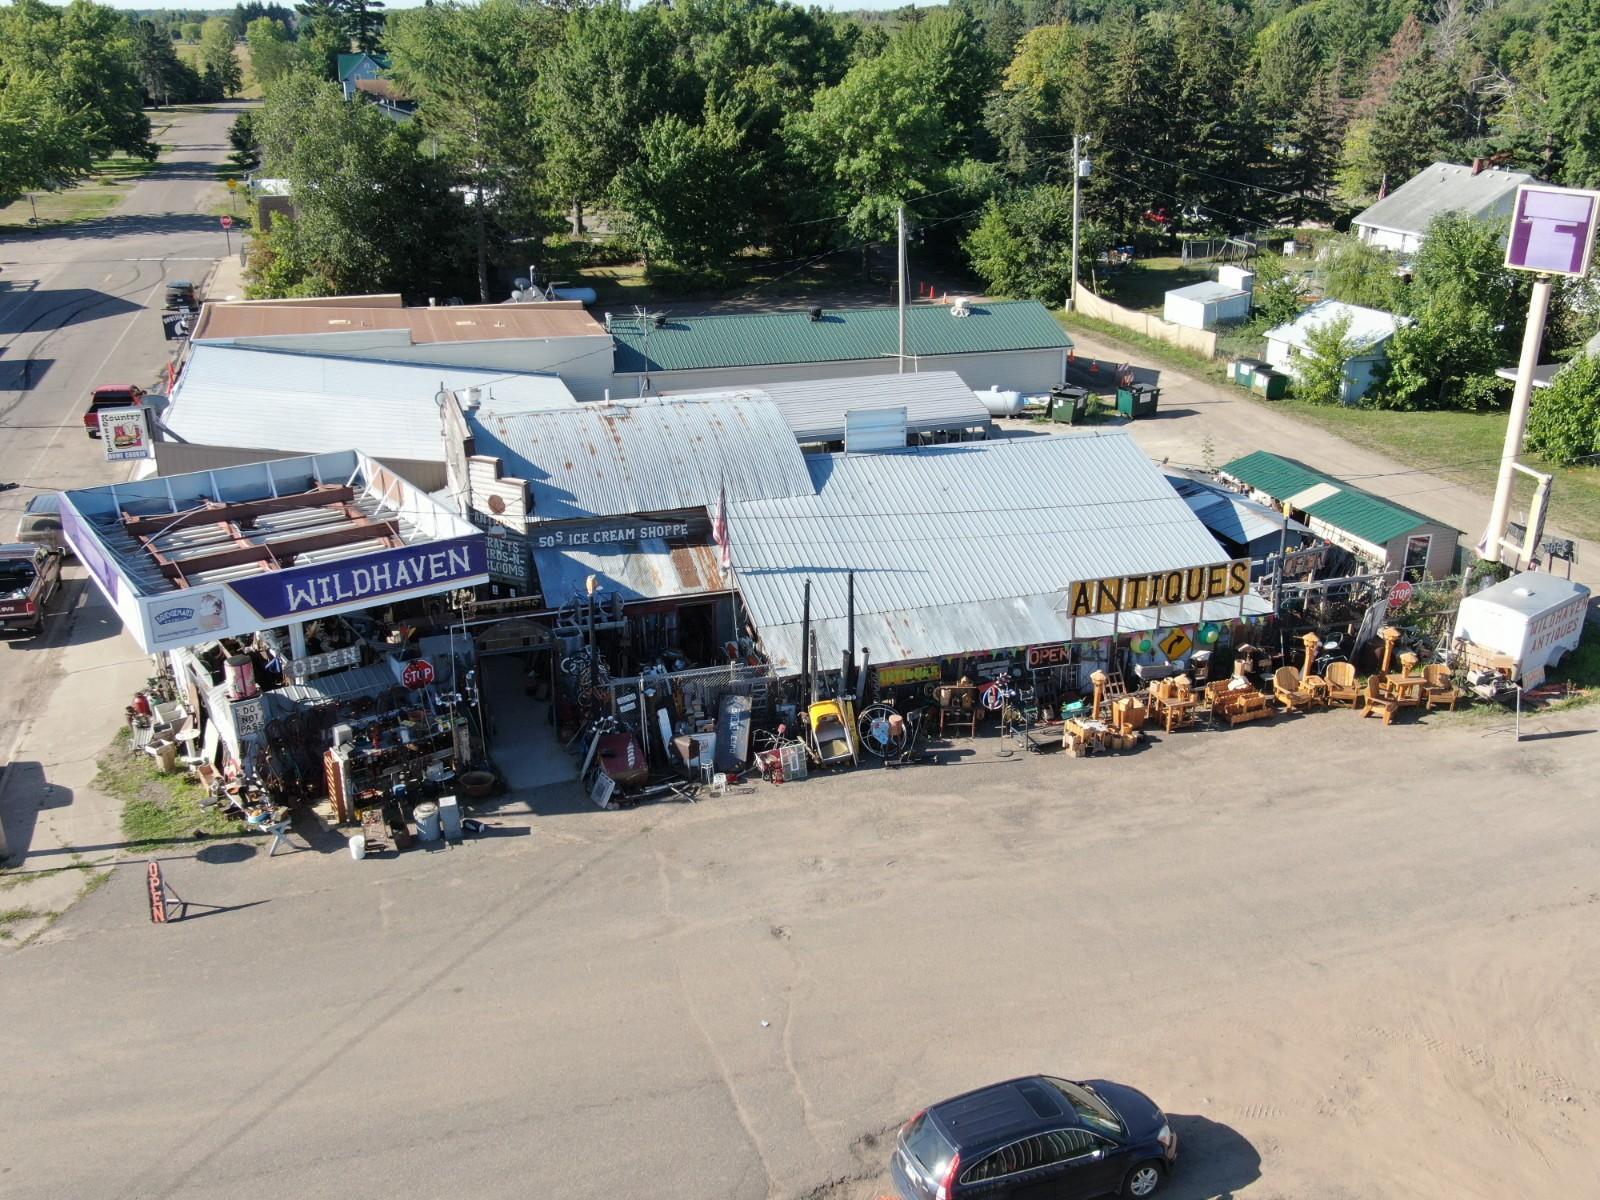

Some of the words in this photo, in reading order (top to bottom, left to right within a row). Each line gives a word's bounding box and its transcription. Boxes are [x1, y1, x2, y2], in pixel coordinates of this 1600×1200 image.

[569, 533, 589, 545] ICE
[593, 528, 635, 542] CREAM
[640, 524, 688, 539] SHOPPE
[286, 545, 471, 611] WILDHAVEN
[1072, 562, 1247, 616] ANTIQUES
[1390, 589, 1410, 600] STOP
[1529, 596, 1589, 637] WILDHAVEN
[1530, 618, 1579, 655] ANTIQUES
[293, 647, 357, 677] OPEN
[1030, 648, 1069, 665] OPEN
[241, 713, 259, 724] NOT
[243, 705, 255, 714] DO
[241, 723, 263, 732] PASS
[148, 862, 165, 922] OPEN
